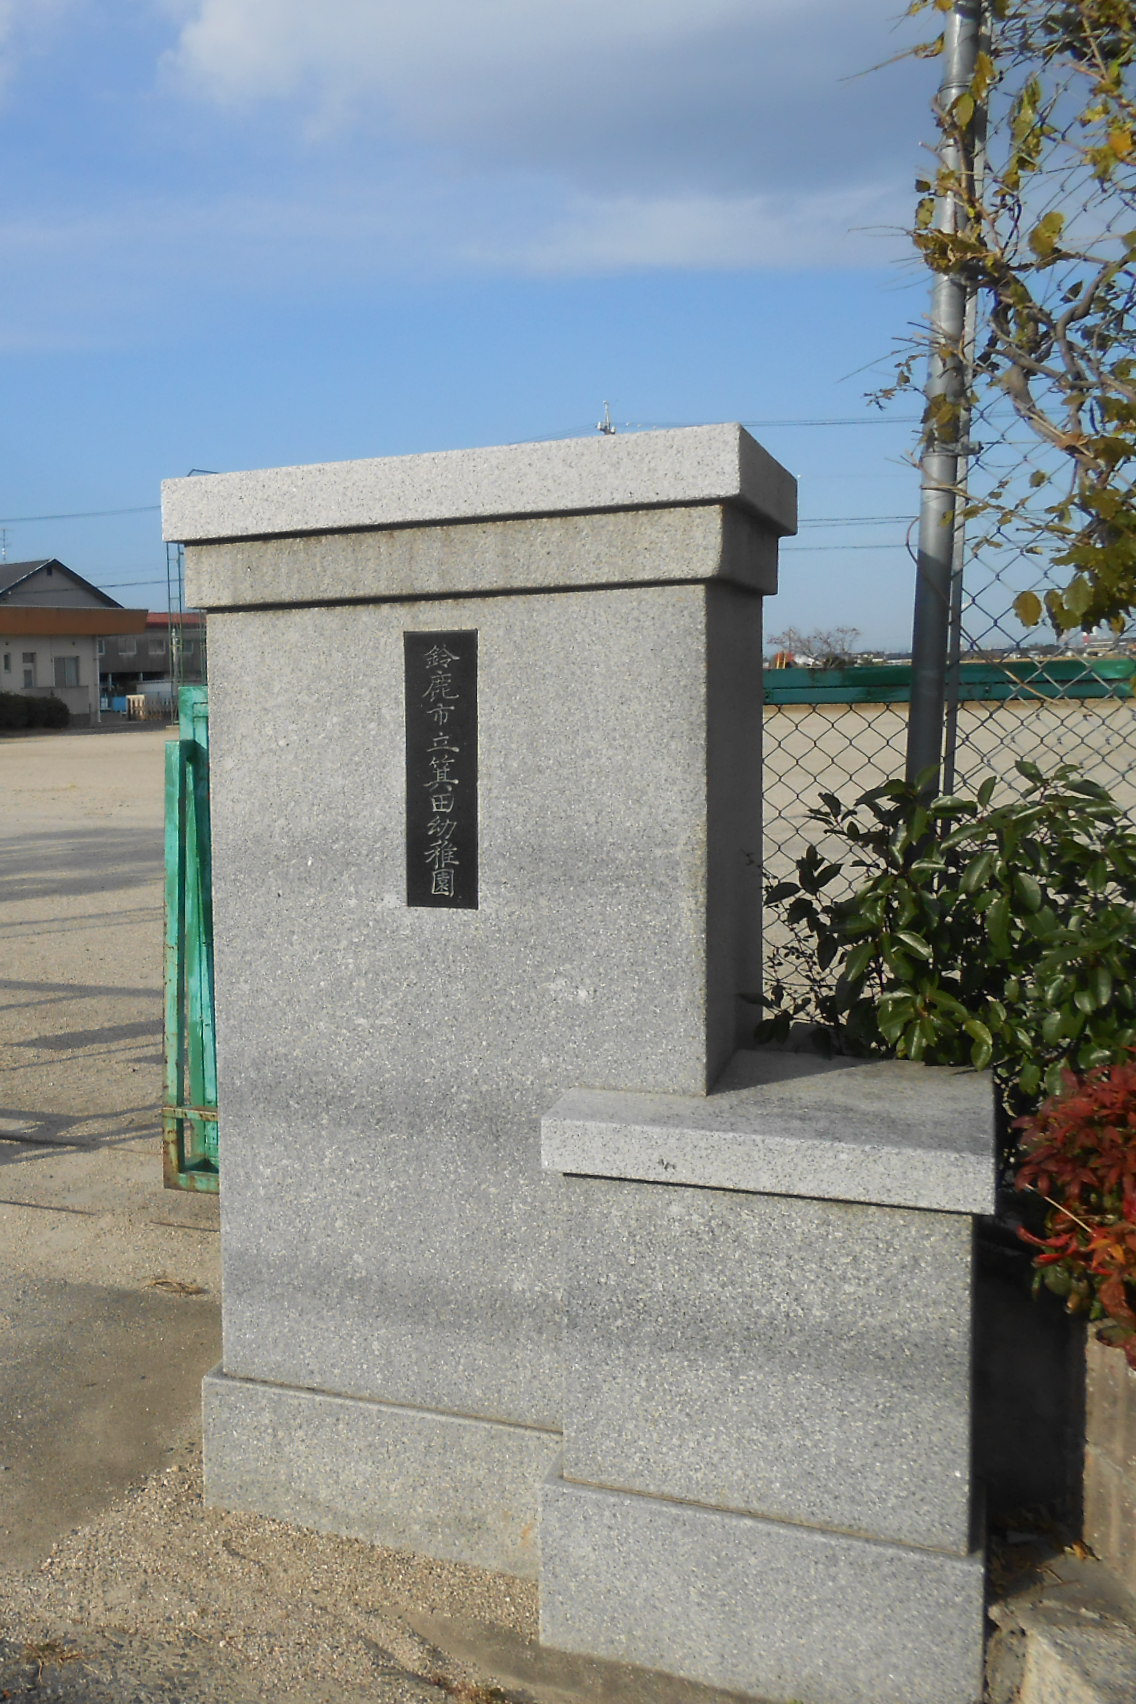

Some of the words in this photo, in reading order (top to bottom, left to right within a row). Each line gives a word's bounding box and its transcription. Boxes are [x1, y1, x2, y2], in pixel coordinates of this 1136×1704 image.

[422, 644, 461, 898] 鈴鹿市立箕田幼稚園
